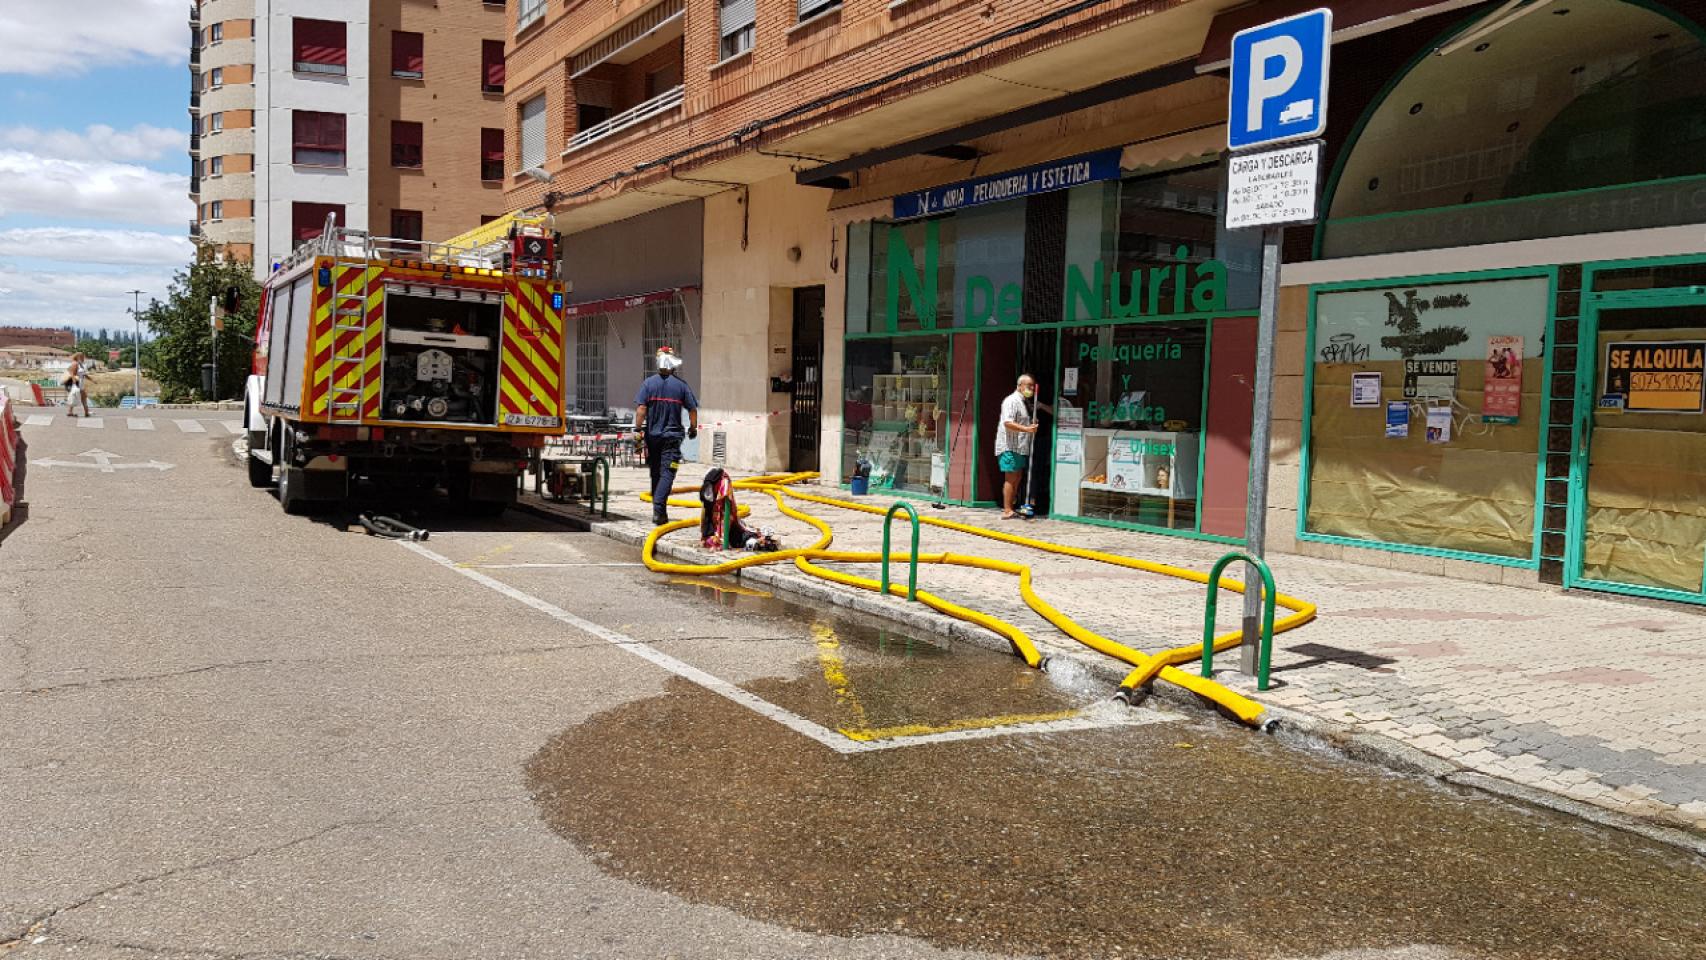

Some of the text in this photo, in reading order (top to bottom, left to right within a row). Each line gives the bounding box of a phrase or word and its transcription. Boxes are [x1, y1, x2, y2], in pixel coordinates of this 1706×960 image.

[1247, 35, 1303, 132] P
[1232, 150, 1314, 174] CARGA Y DESCARGA
[973, 174, 1028, 203] PELUQUERIA
[1032, 171, 1039, 192] Y
[1041, 160, 1090, 189] ESTETICA
[887, 221, 1228, 333] N De Nuria
[1407, 359, 1457, 374] SE VENDE
[1610, 348, 1703, 369] SE ALQUILA
[1121, 374, 1132, 390] Y
[1130, 440, 1176, 456] Unisex
